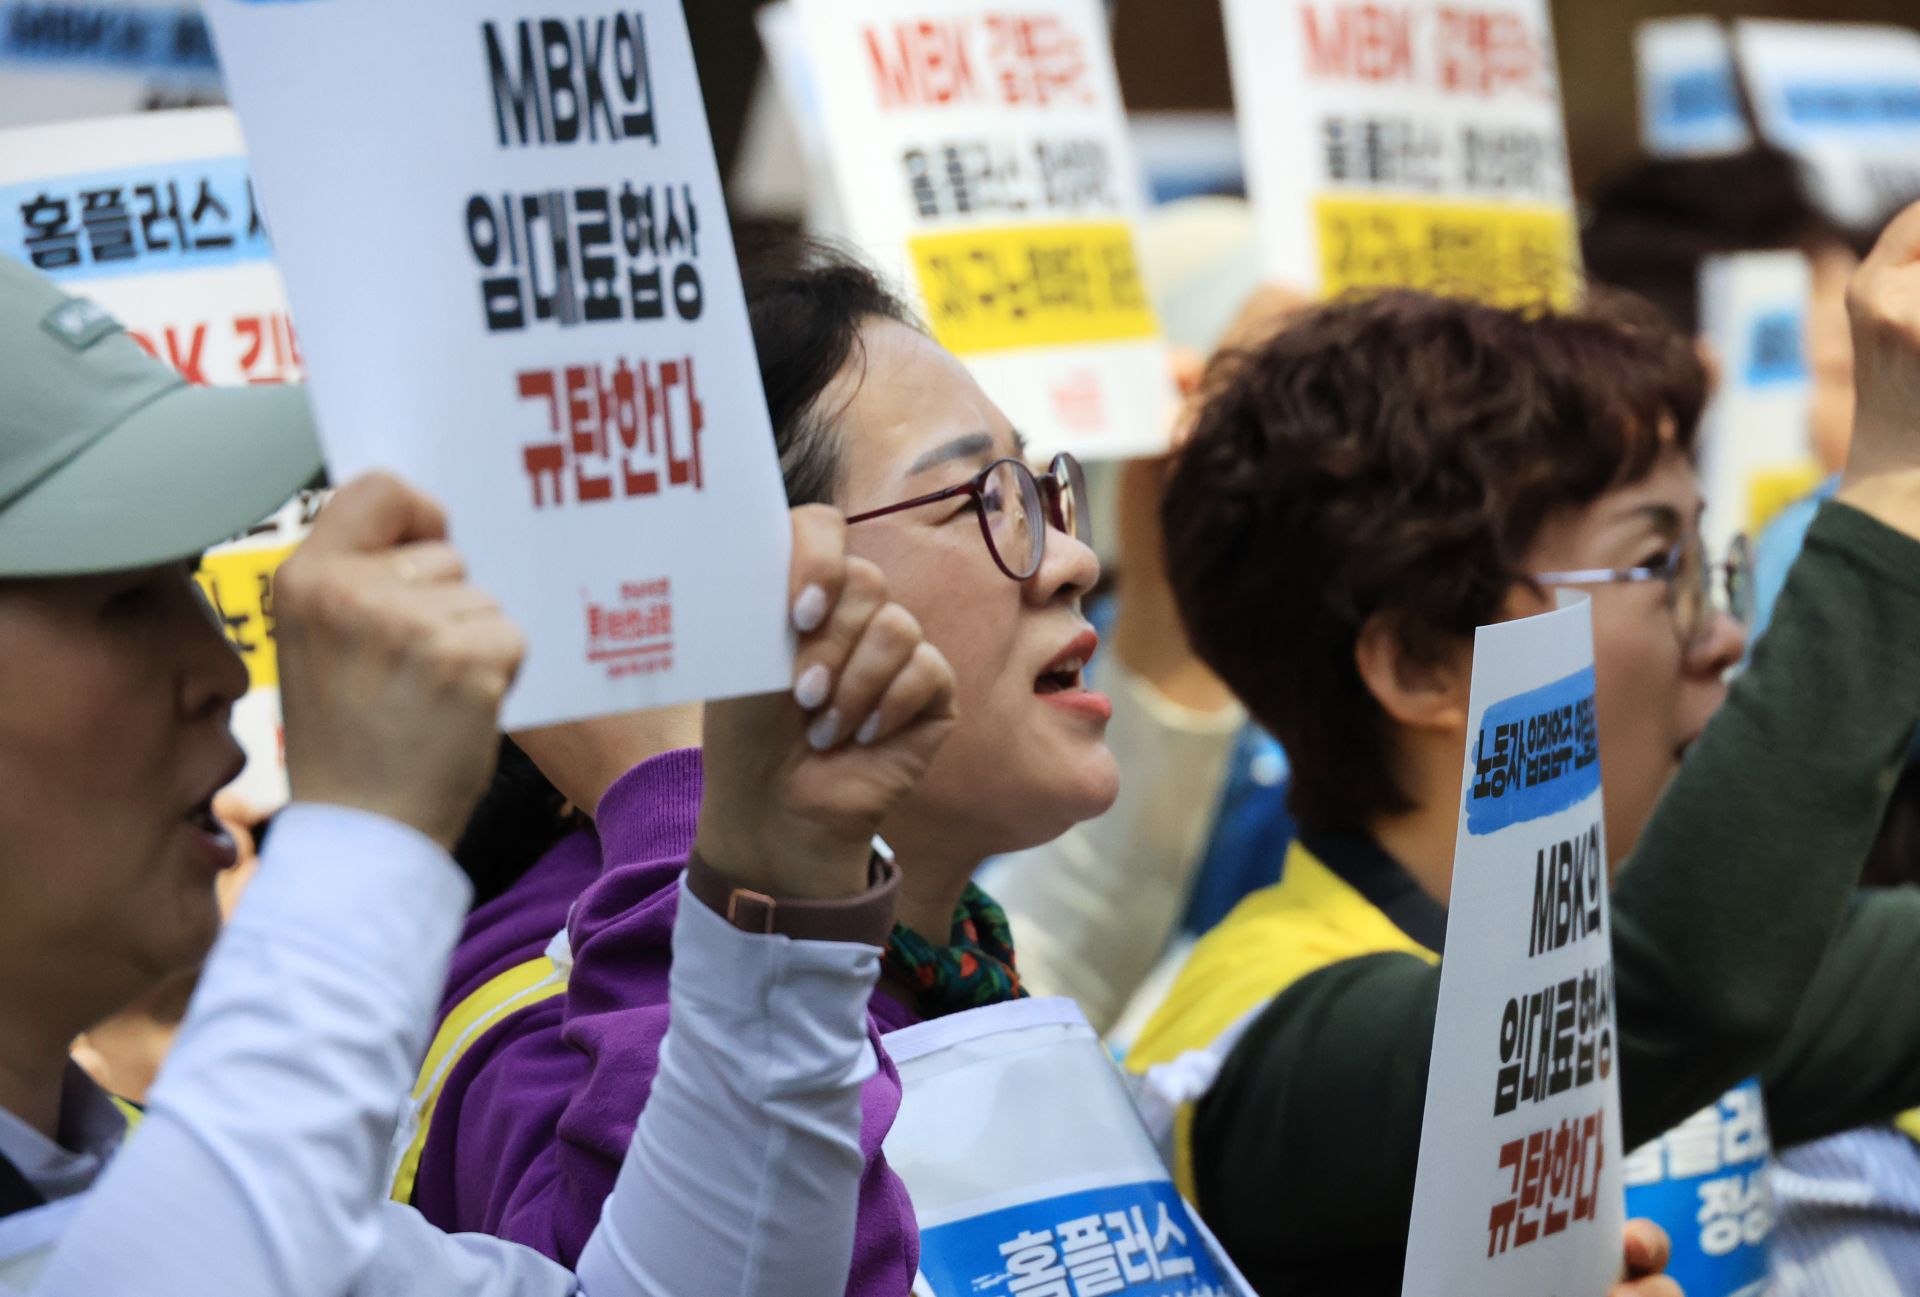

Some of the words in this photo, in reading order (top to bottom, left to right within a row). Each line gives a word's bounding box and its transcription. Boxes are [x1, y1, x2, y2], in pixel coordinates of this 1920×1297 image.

[479, 11, 660, 146] MBK의
[20, 177, 236, 270] 홈플러스
[464, 181, 704, 331] 임대료협상
[514, 355, 704, 509] 규탄한다
[1474, 719, 1526, 799] 노동자
[1526, 704, 1573, 787] 입점업주
[1529, 821, 1601, 957] MBK의
[999, 1202, 1196, 1297] 홈플러스
[1488, 1108, 1603, 1258] 규탄한다
